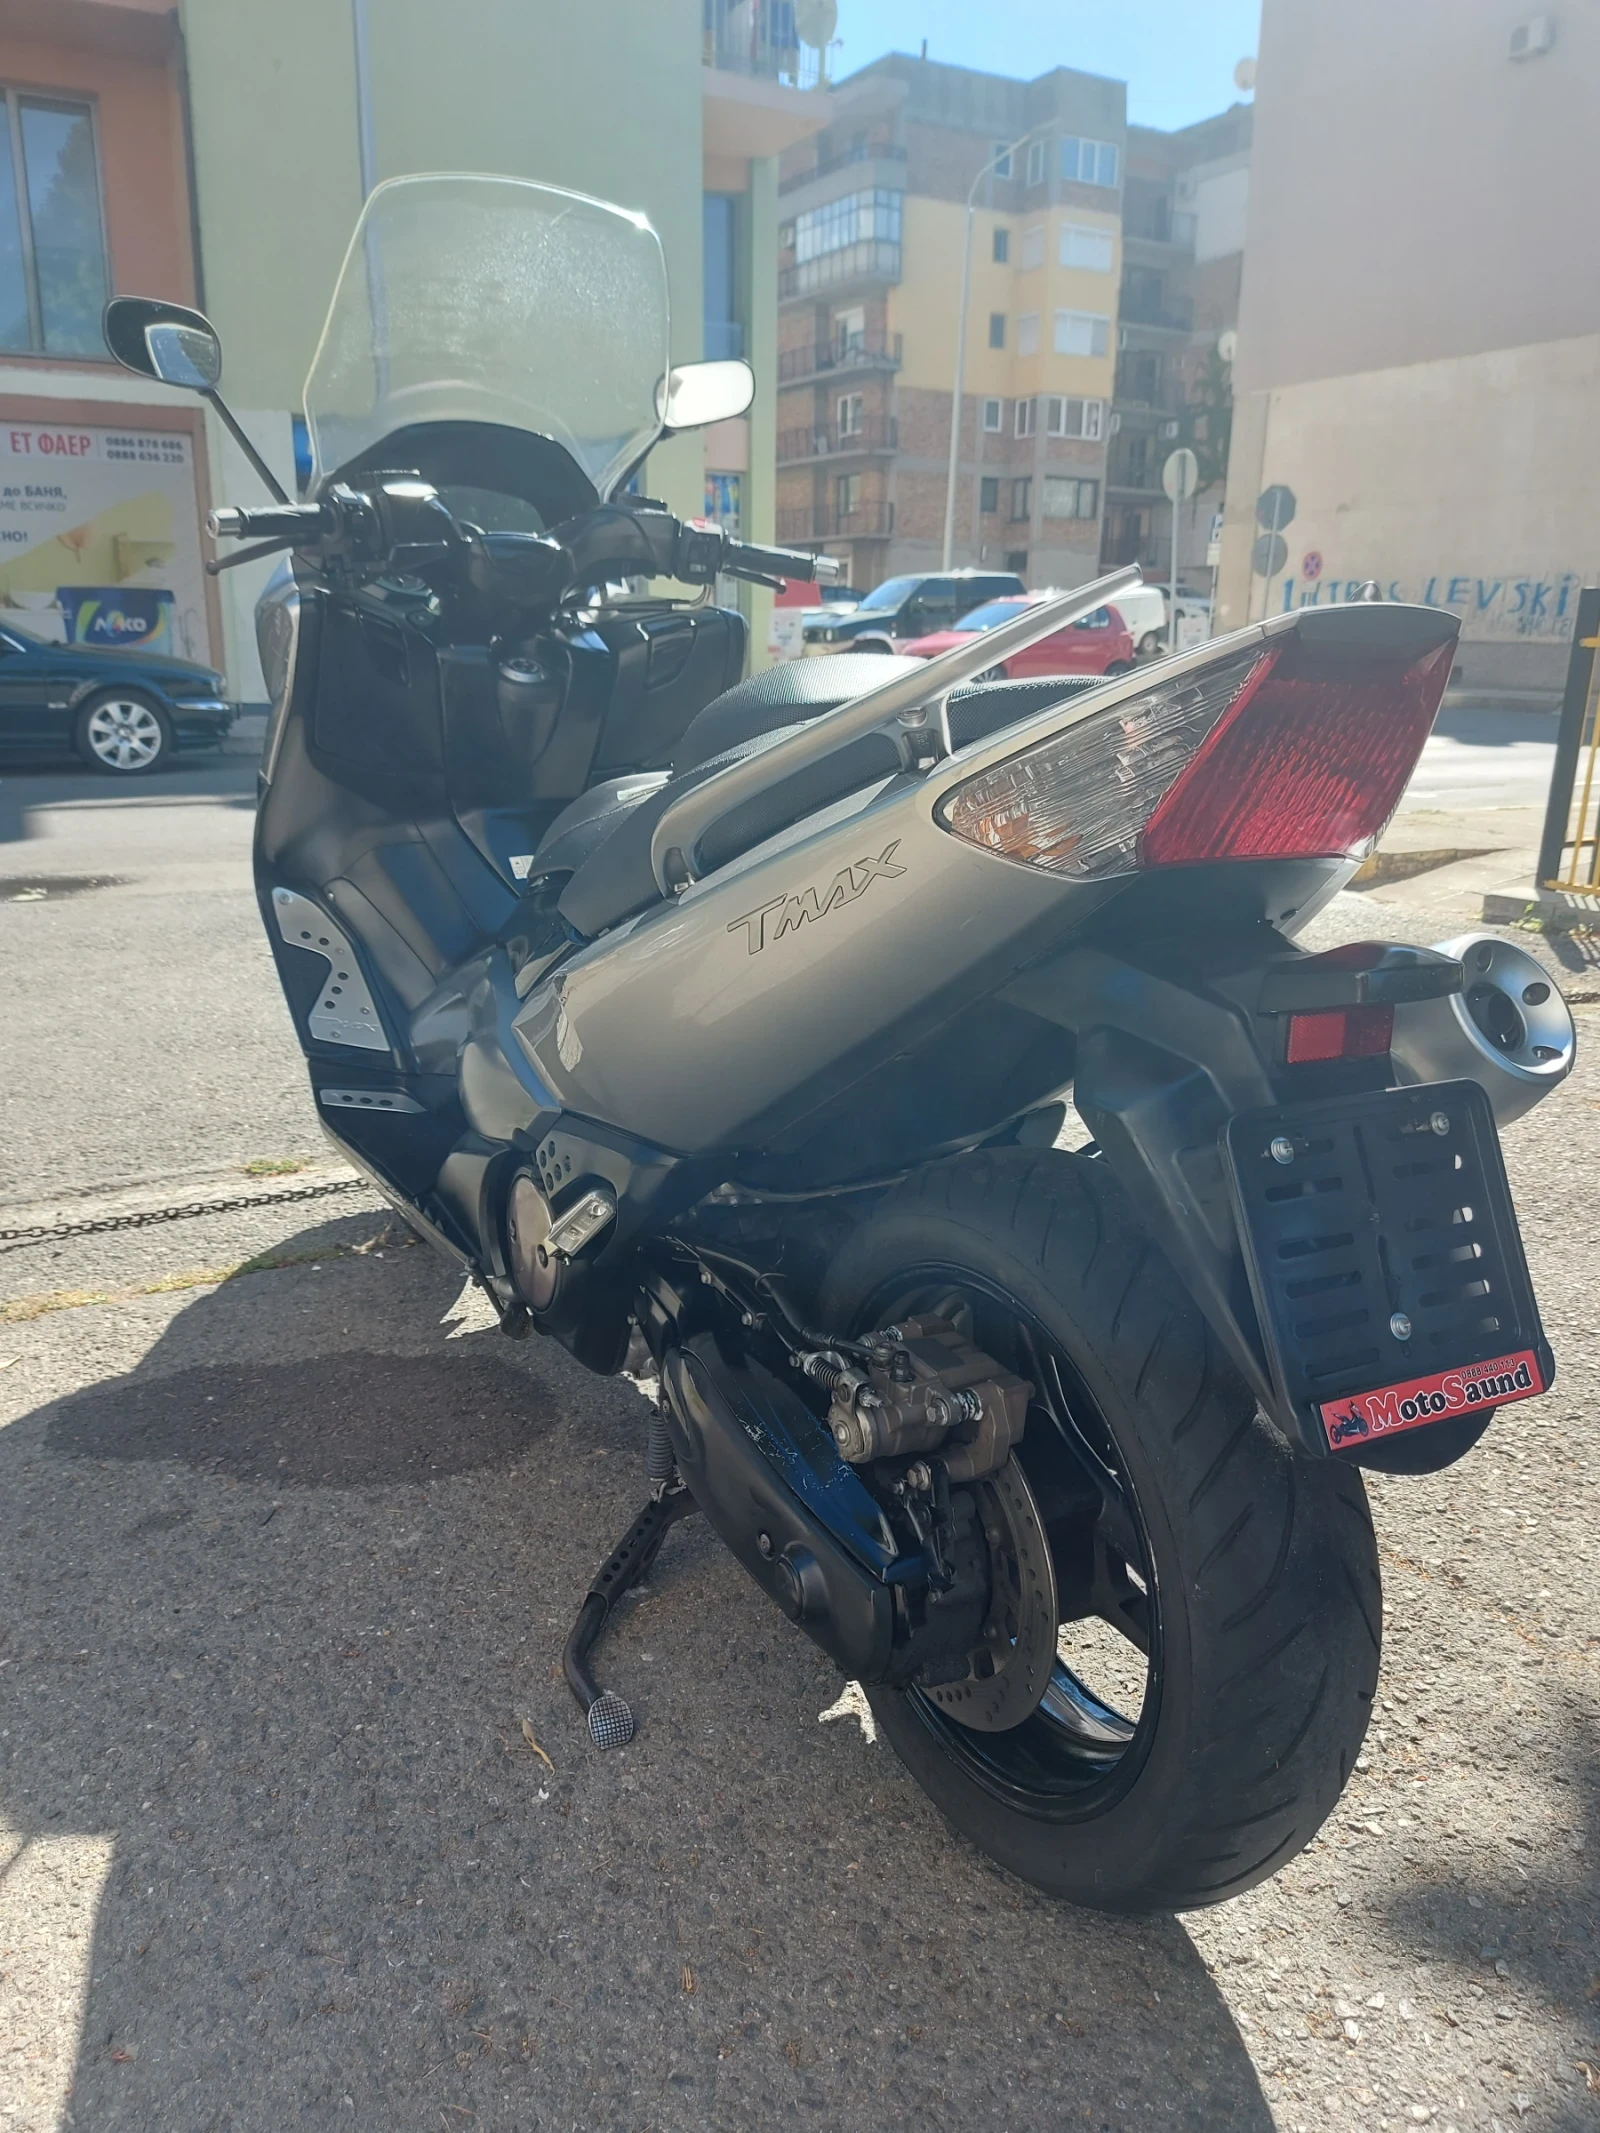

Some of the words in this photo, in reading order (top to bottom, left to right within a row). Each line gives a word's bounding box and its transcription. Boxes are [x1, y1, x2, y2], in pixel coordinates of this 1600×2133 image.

[9, 431, 32, 454] ЕТ
[37, 432, 91, 456] ФАЕР
[727, 838, 907, 955] TMAX
[1366, 1361, 1533, 1432] MotoSaund
